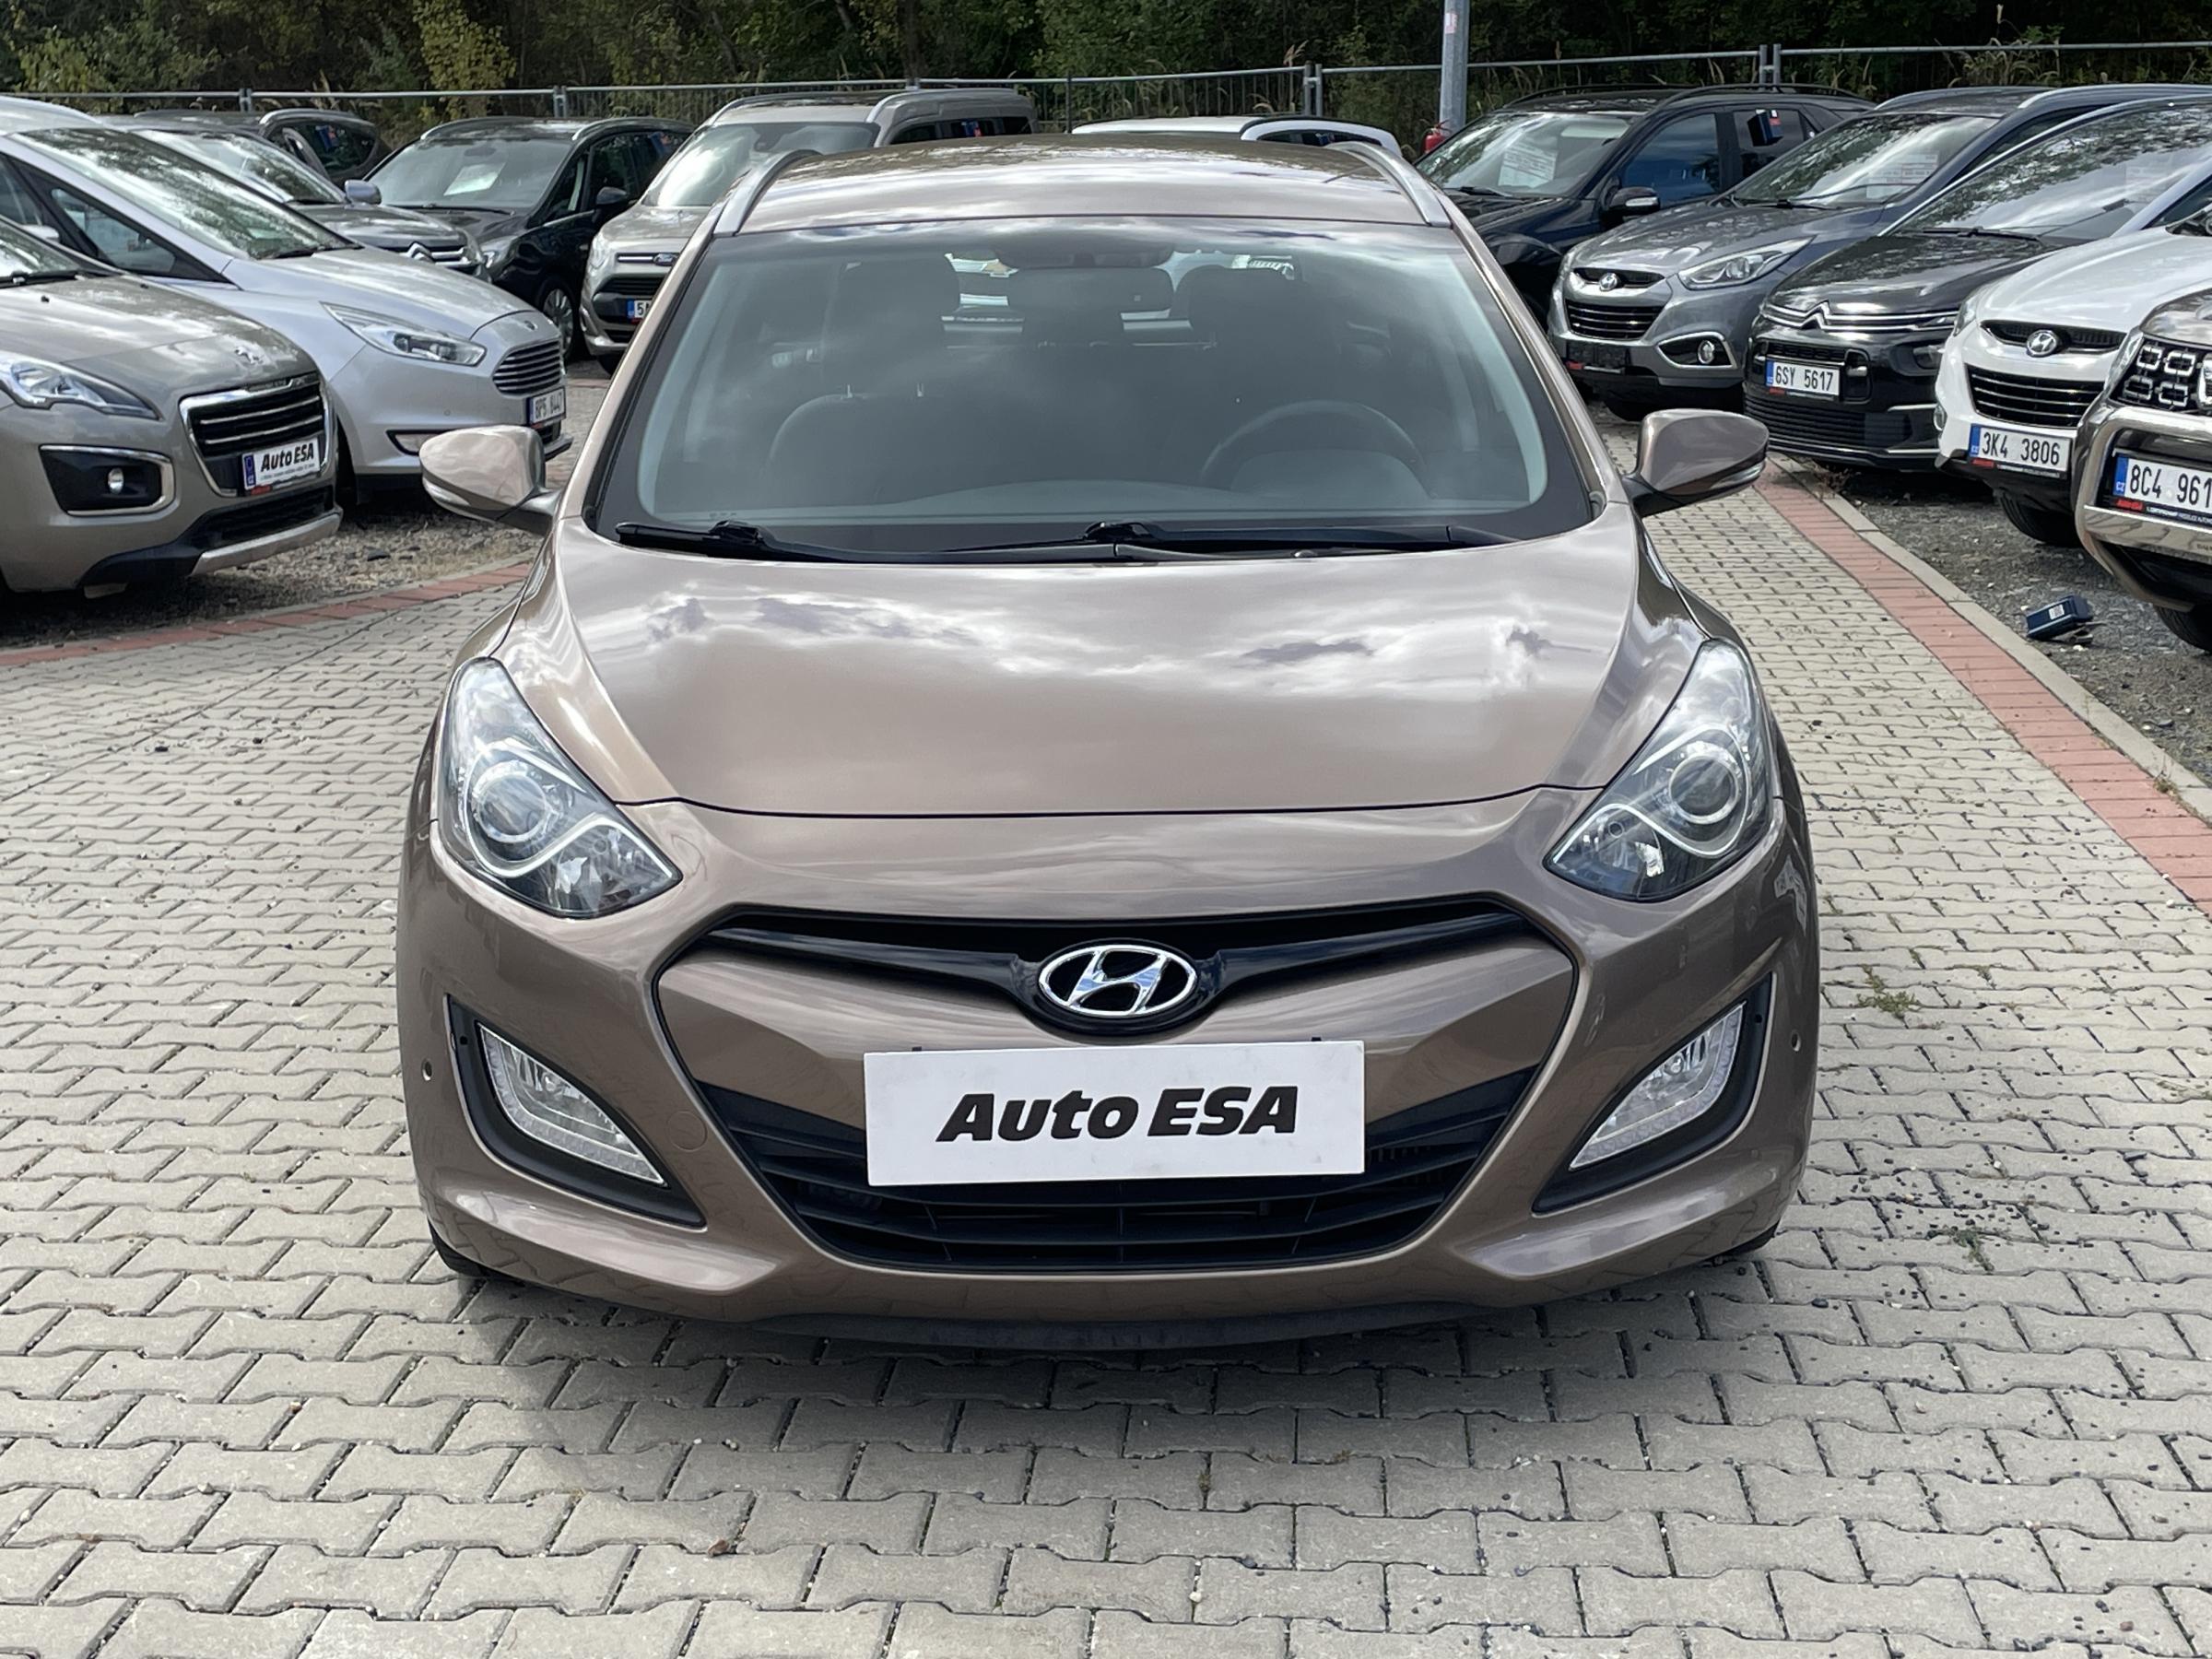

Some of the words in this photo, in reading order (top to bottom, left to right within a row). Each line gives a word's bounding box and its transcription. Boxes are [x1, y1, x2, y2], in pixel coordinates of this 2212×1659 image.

[1775, 366, 1795, 386] 6SY
[1804, 369, 1833, 391] 5617
[261, 450, 292, 472] Auto
[294, 442, 313, 464] ESA
[1983, 432, 2008, 458] 3K4
[2020, 438, 2060, 465] 3806
[2130, 465, 2162, 498] 8C4
[935, 1089, 1138, 1142] Auto
[1147, 1086, 1298, 1136] ESA
